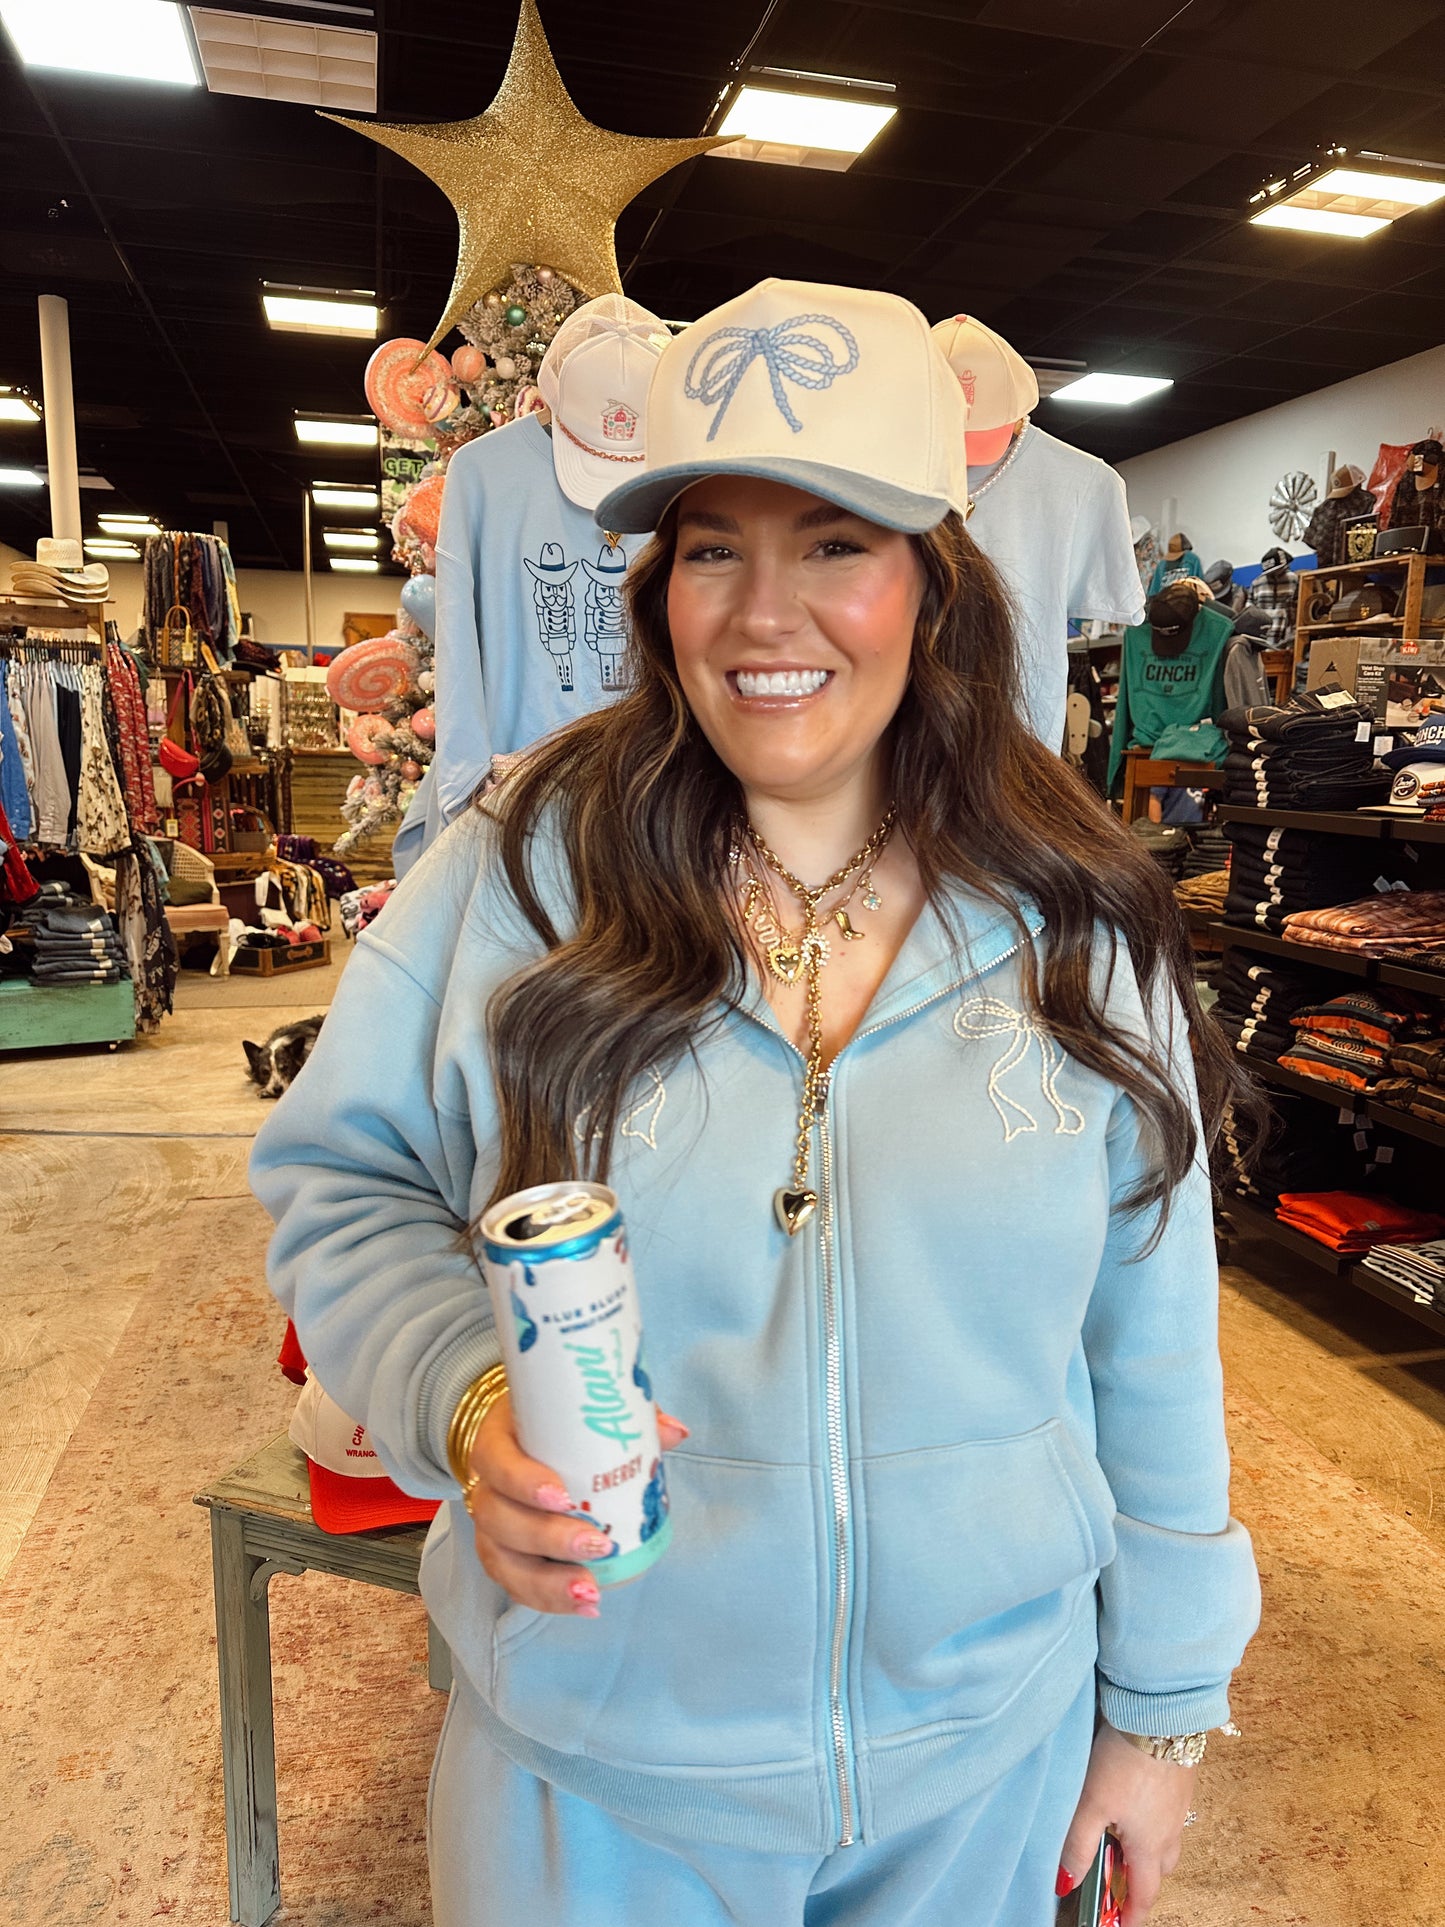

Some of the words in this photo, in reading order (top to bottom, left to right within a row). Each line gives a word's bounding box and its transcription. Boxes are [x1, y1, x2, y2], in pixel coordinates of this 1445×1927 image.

[1146, 664, 1197, 682] CINCH
[562, 1342, 642, 1452] Alani
[346, 1448, 378, 1457] WRANG
[592, 1454, 643, 1493] ENERGY
